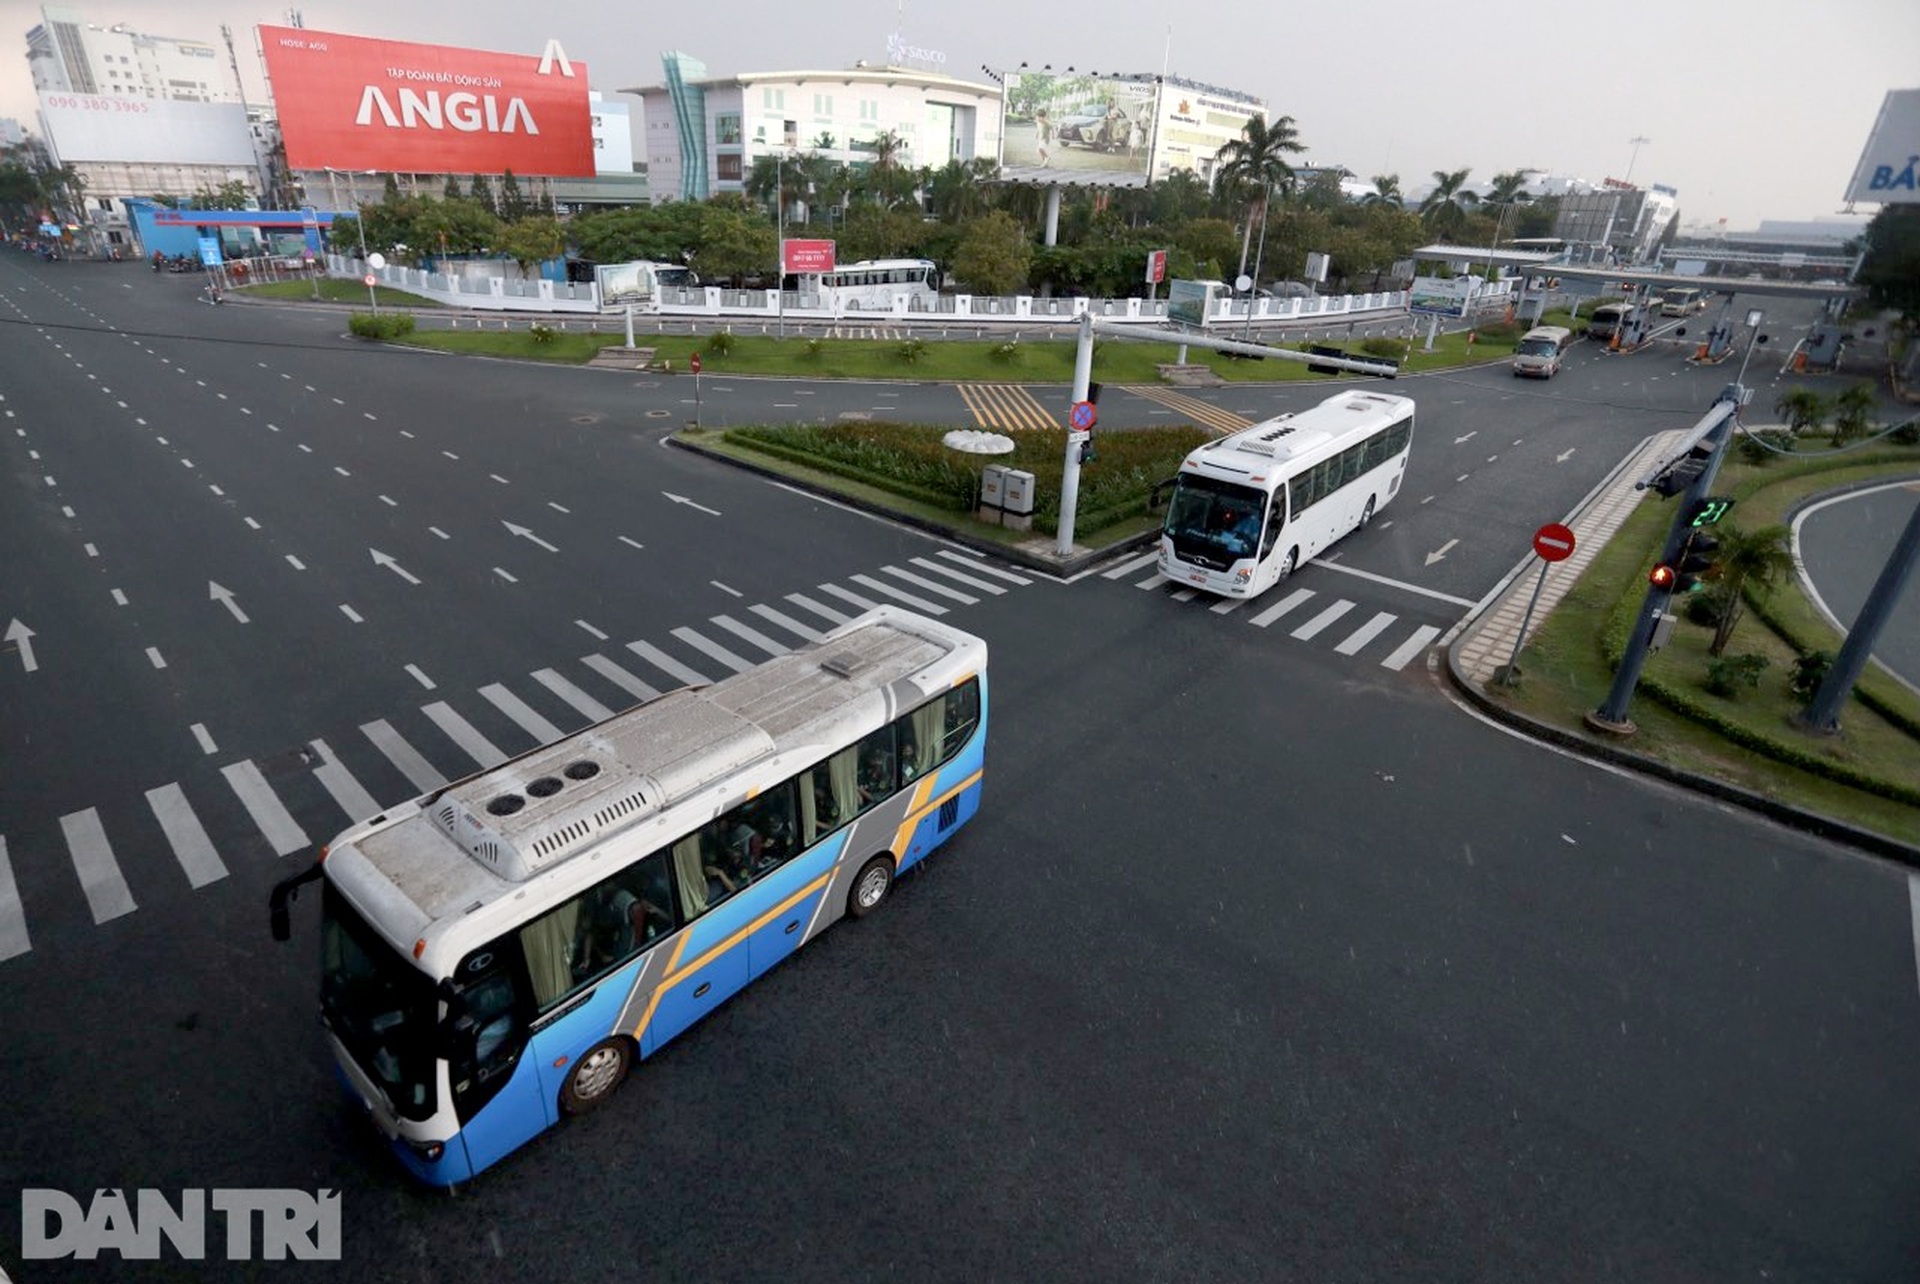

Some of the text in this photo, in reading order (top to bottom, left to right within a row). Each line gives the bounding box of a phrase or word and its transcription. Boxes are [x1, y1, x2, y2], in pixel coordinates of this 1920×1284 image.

[48, 96, 149, 113] 090 380 3965
